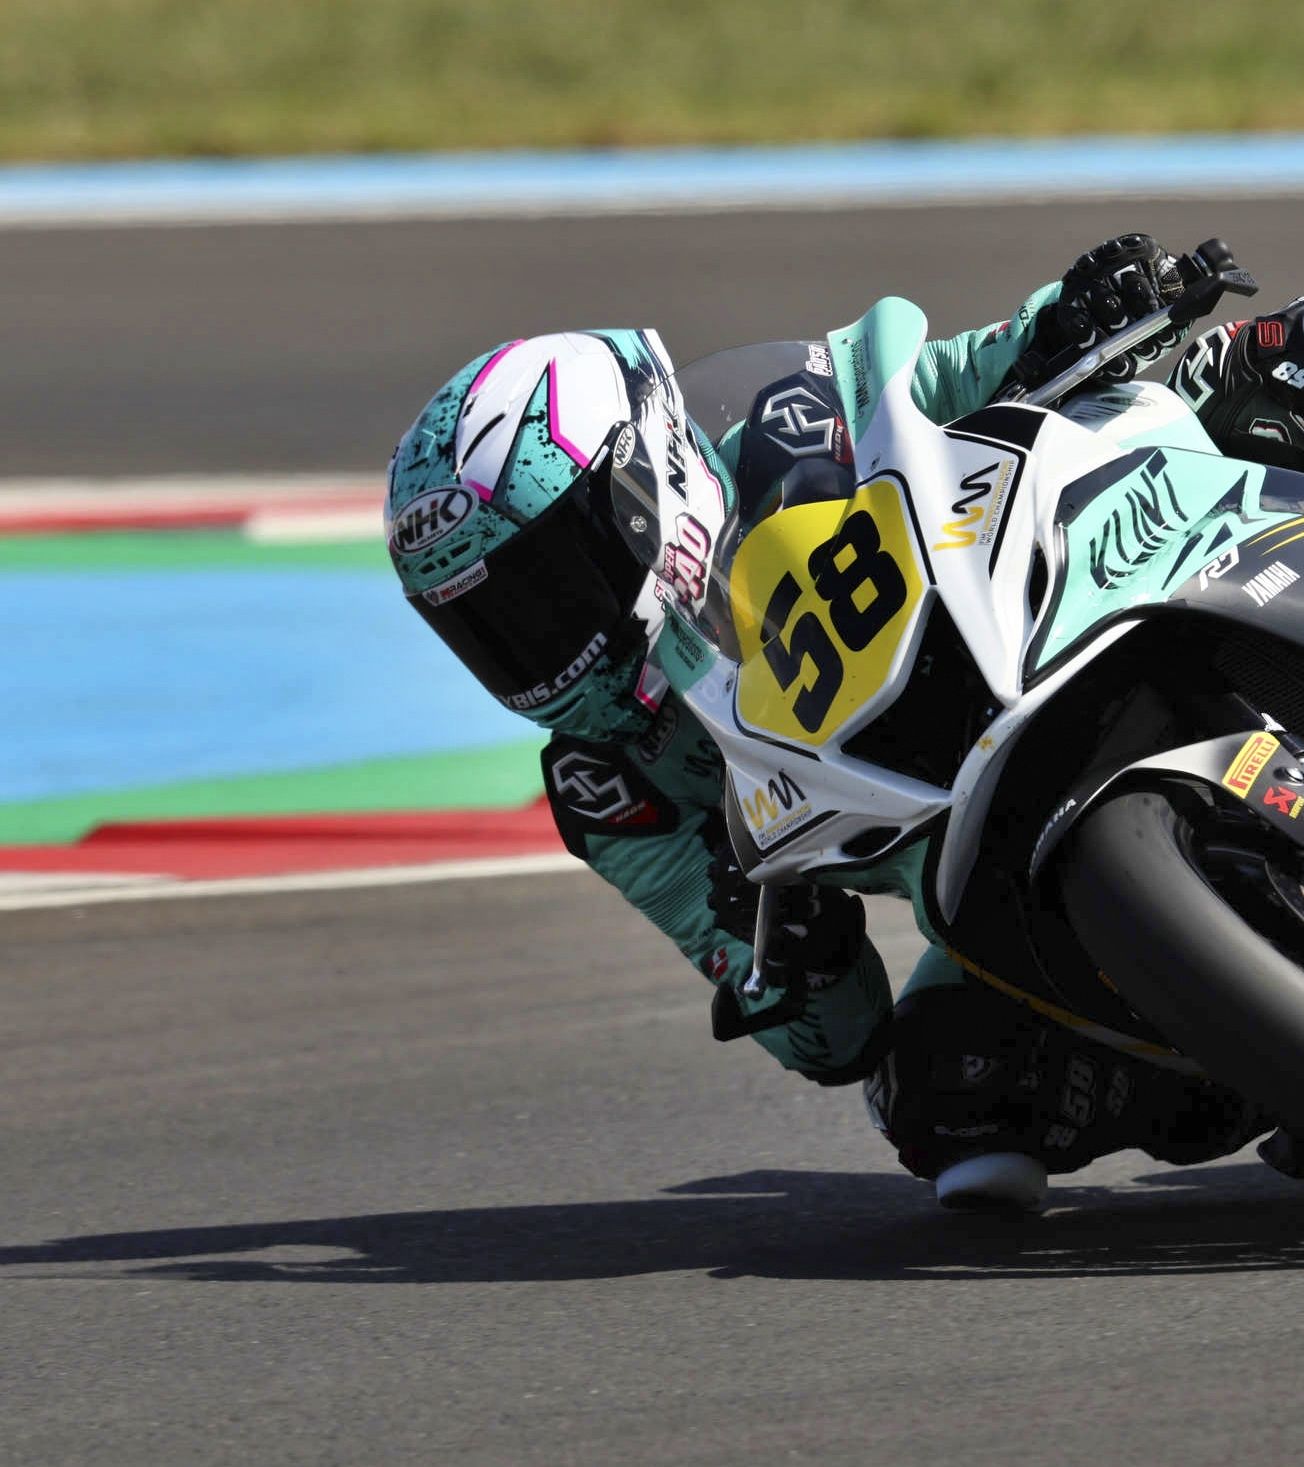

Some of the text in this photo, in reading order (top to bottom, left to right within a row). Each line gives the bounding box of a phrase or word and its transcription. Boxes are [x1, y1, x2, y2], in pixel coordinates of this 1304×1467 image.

[615, 426, 633, 465] NHK
[396, 489, 460, 552] NHK
[1241, 560, 1301, 608] YAMAHA
[760, 510, 907, 733] 58
[1228, 736, 1275, 790] PIRELLI
